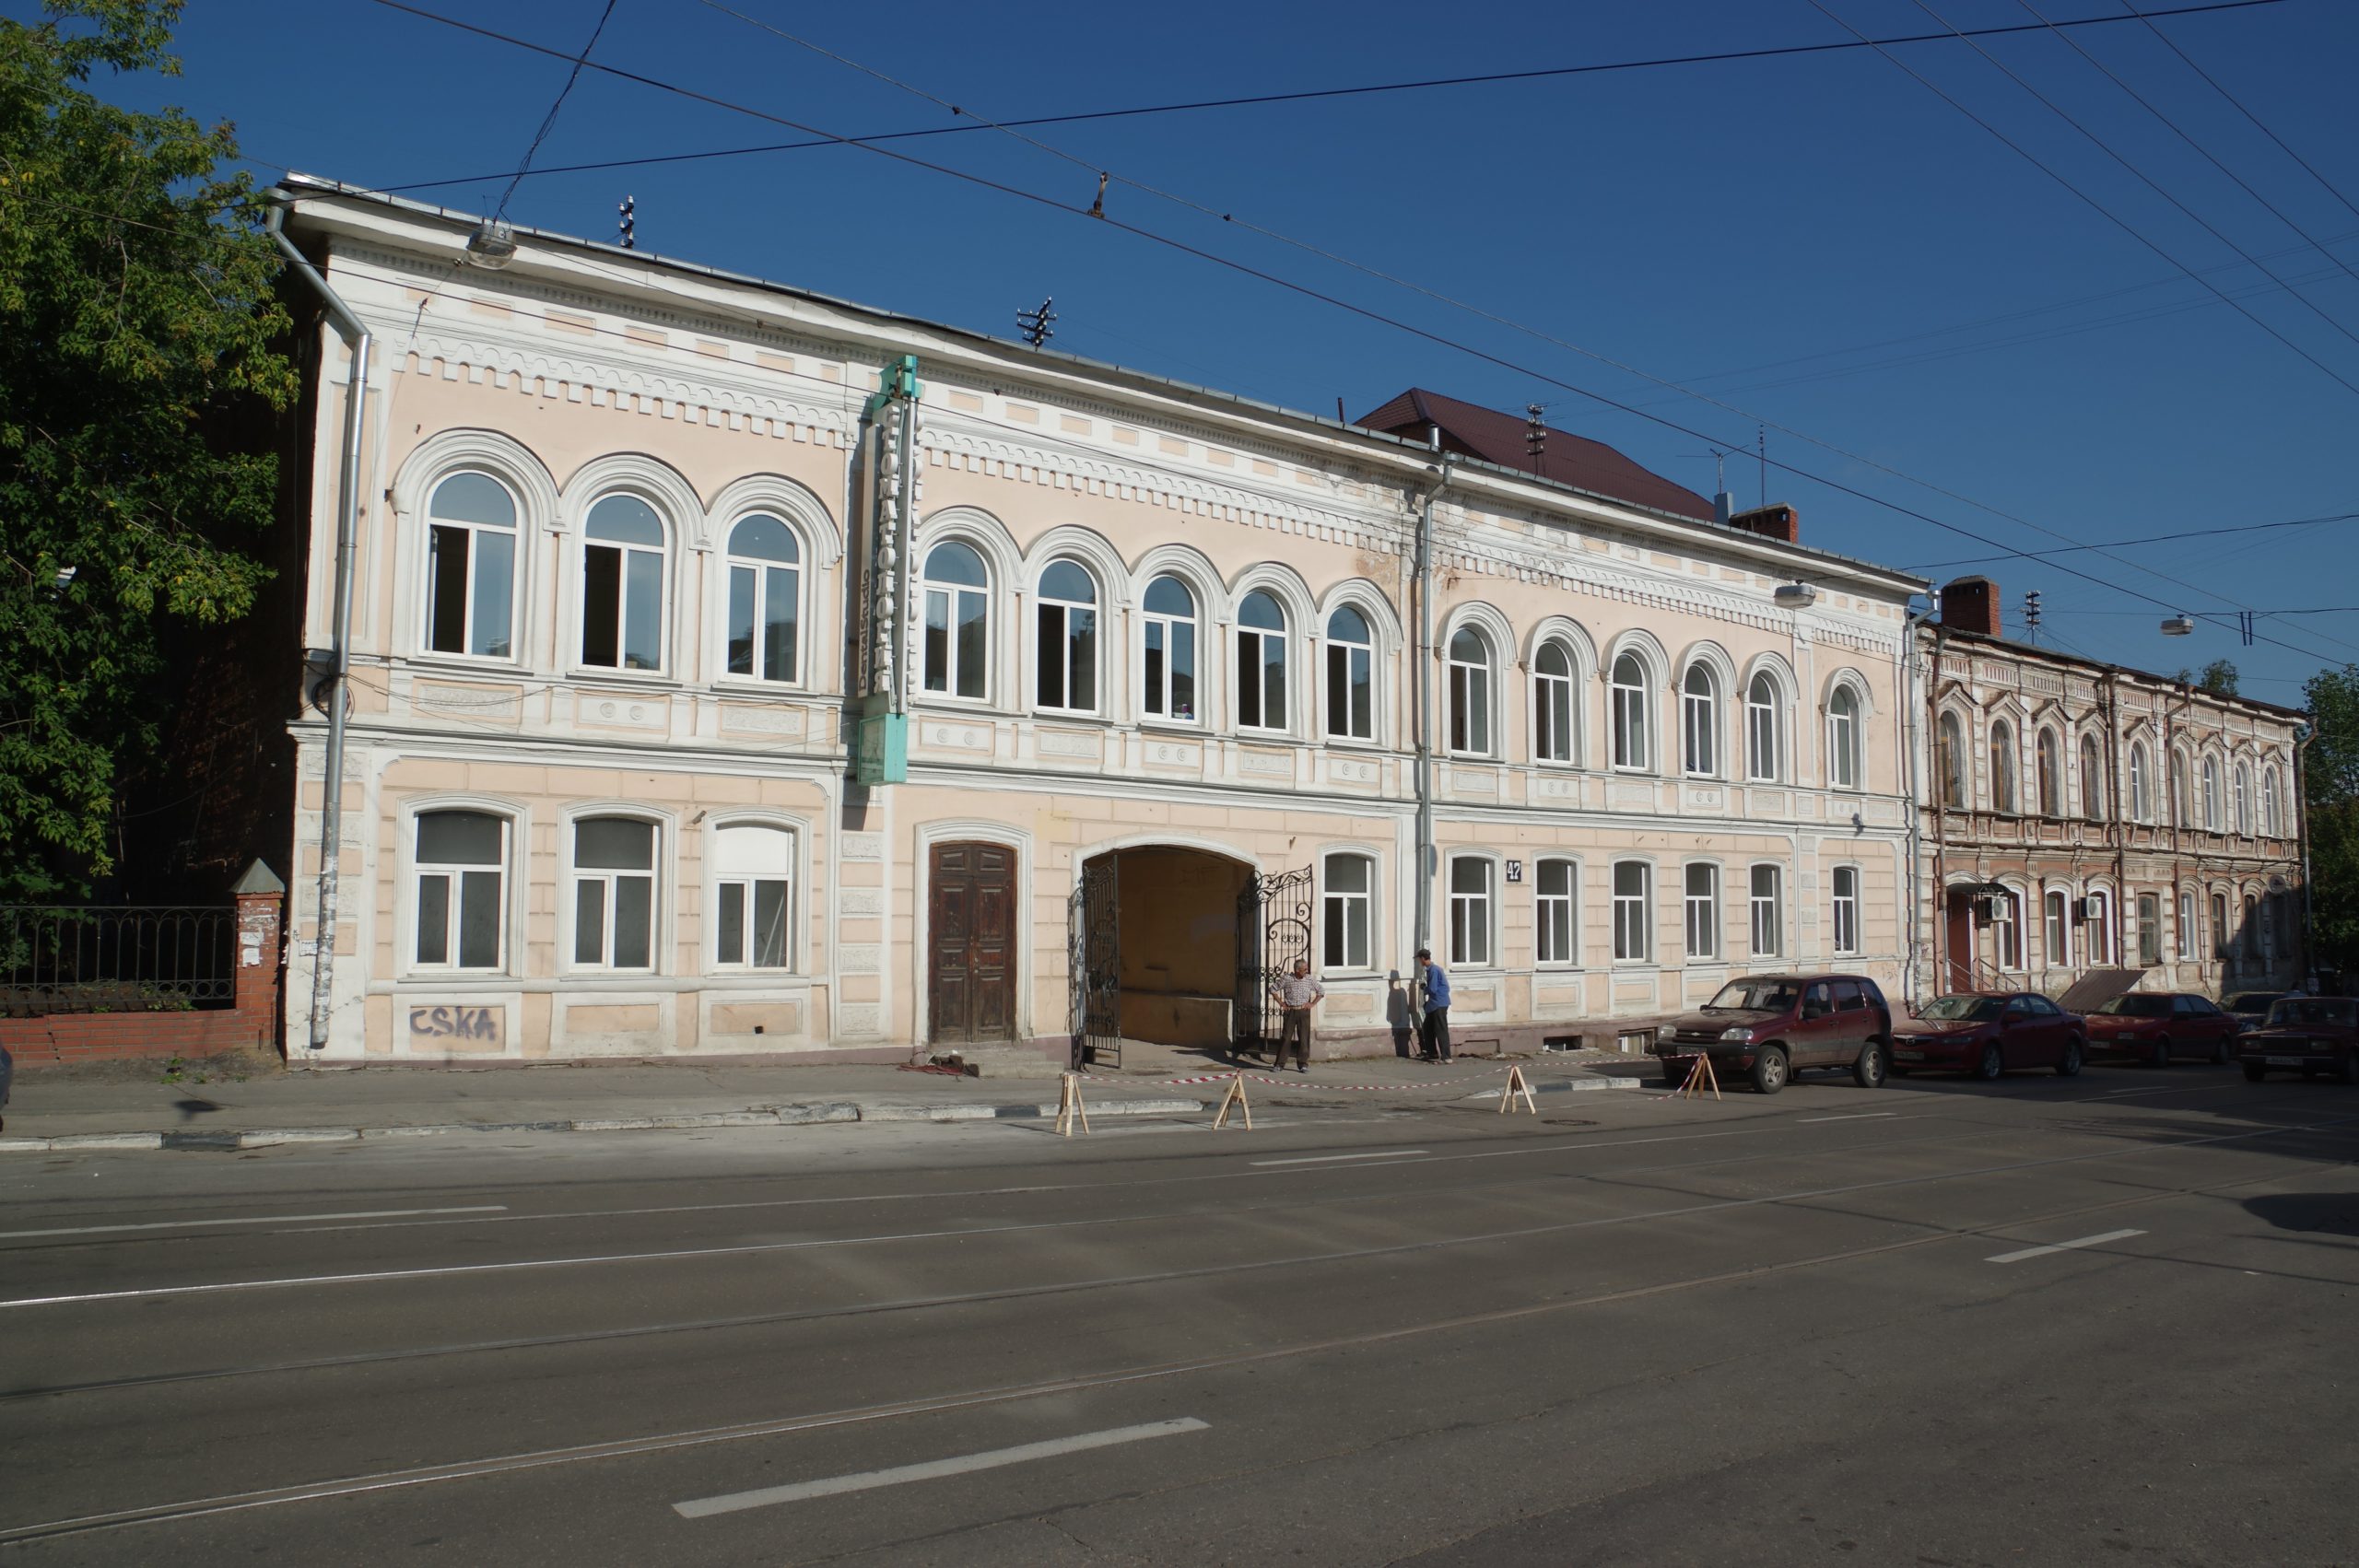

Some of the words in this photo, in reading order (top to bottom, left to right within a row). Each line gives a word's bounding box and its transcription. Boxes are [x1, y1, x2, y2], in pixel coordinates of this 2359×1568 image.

[874, 405, 900, 694] СТОМАТОЛОГИЯ
[859, 568, 871, 692] DentalStudio
[410, 1005, 497, 1042] CSKA
